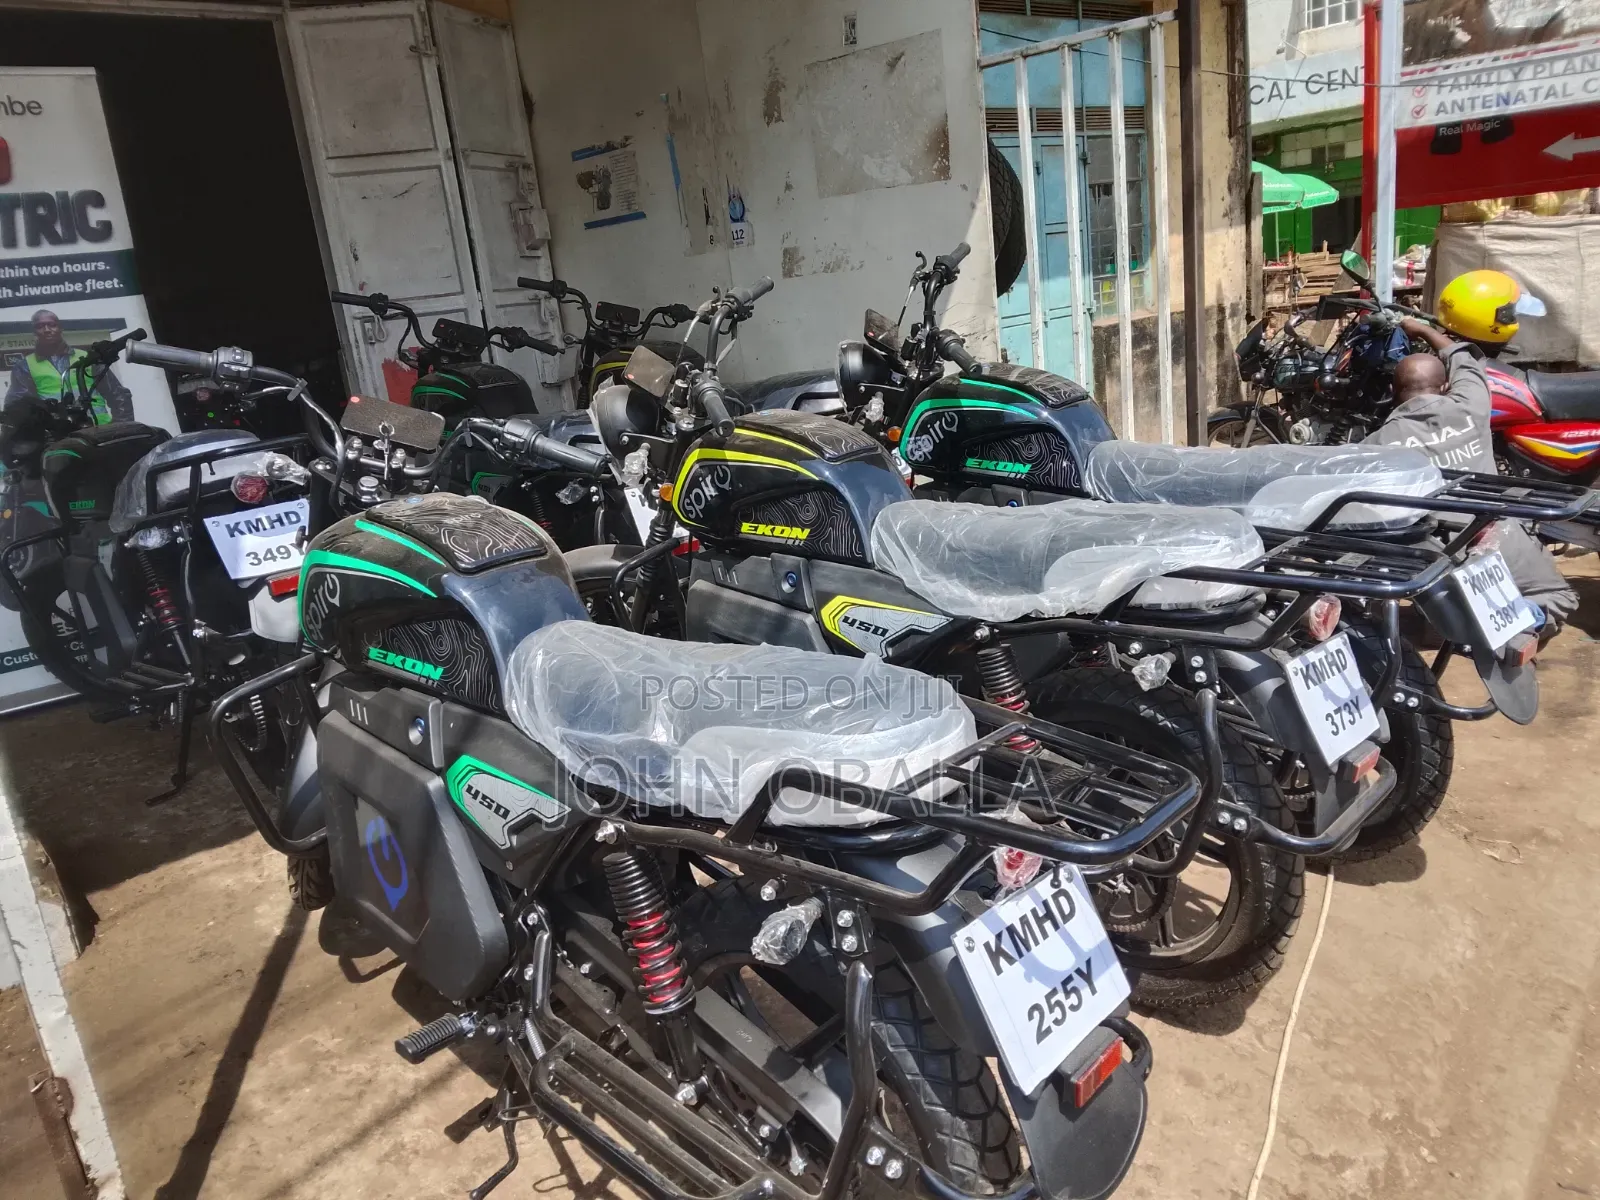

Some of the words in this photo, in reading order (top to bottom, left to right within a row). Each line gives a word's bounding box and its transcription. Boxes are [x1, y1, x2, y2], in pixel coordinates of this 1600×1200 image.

[1250, 79, 1296, 105] CAL
[1306, 66, 1364, 95] CEN
[1435, 67, 1524, 95] FAMILY
[1435, 82, 1574, 116] ANTENATAL
[1439, 124, 1463, 136] Real
[1467, 119, 1500, 133] Magic
[32, 264, 60, 276] two
[63, 261, 110, 273] hours.
[15, 281, 83, 297] Jiwambe
[85, 278, 124, 293] fleet.
[1388, 415, 1475, 448] AJAJ
[965, 458, 1032, 474] EKON
[1429, 439, 1483, 468] UINE
[225, 511, 301, 538] KMHD
[740, 522, 810, 540] EKON
[246, 542, 305, 566] 349Y
[1468, 564, 1505, 596] KMHD
[305, 573, 340, 641] spiro
[1489, 607, 1520, 633] 338Y
[842, 615, 890, 638] 450
[368, 647, 444, 682] EKON
[1300, 648, 1348, 690] KMHD
[1325, 696, 1363, 737] 373Y
[465, 784, 511, 821] 450
[982, 888, 1076, 976] KMHD
[1027, 957, 1098, 1045] 255Y
